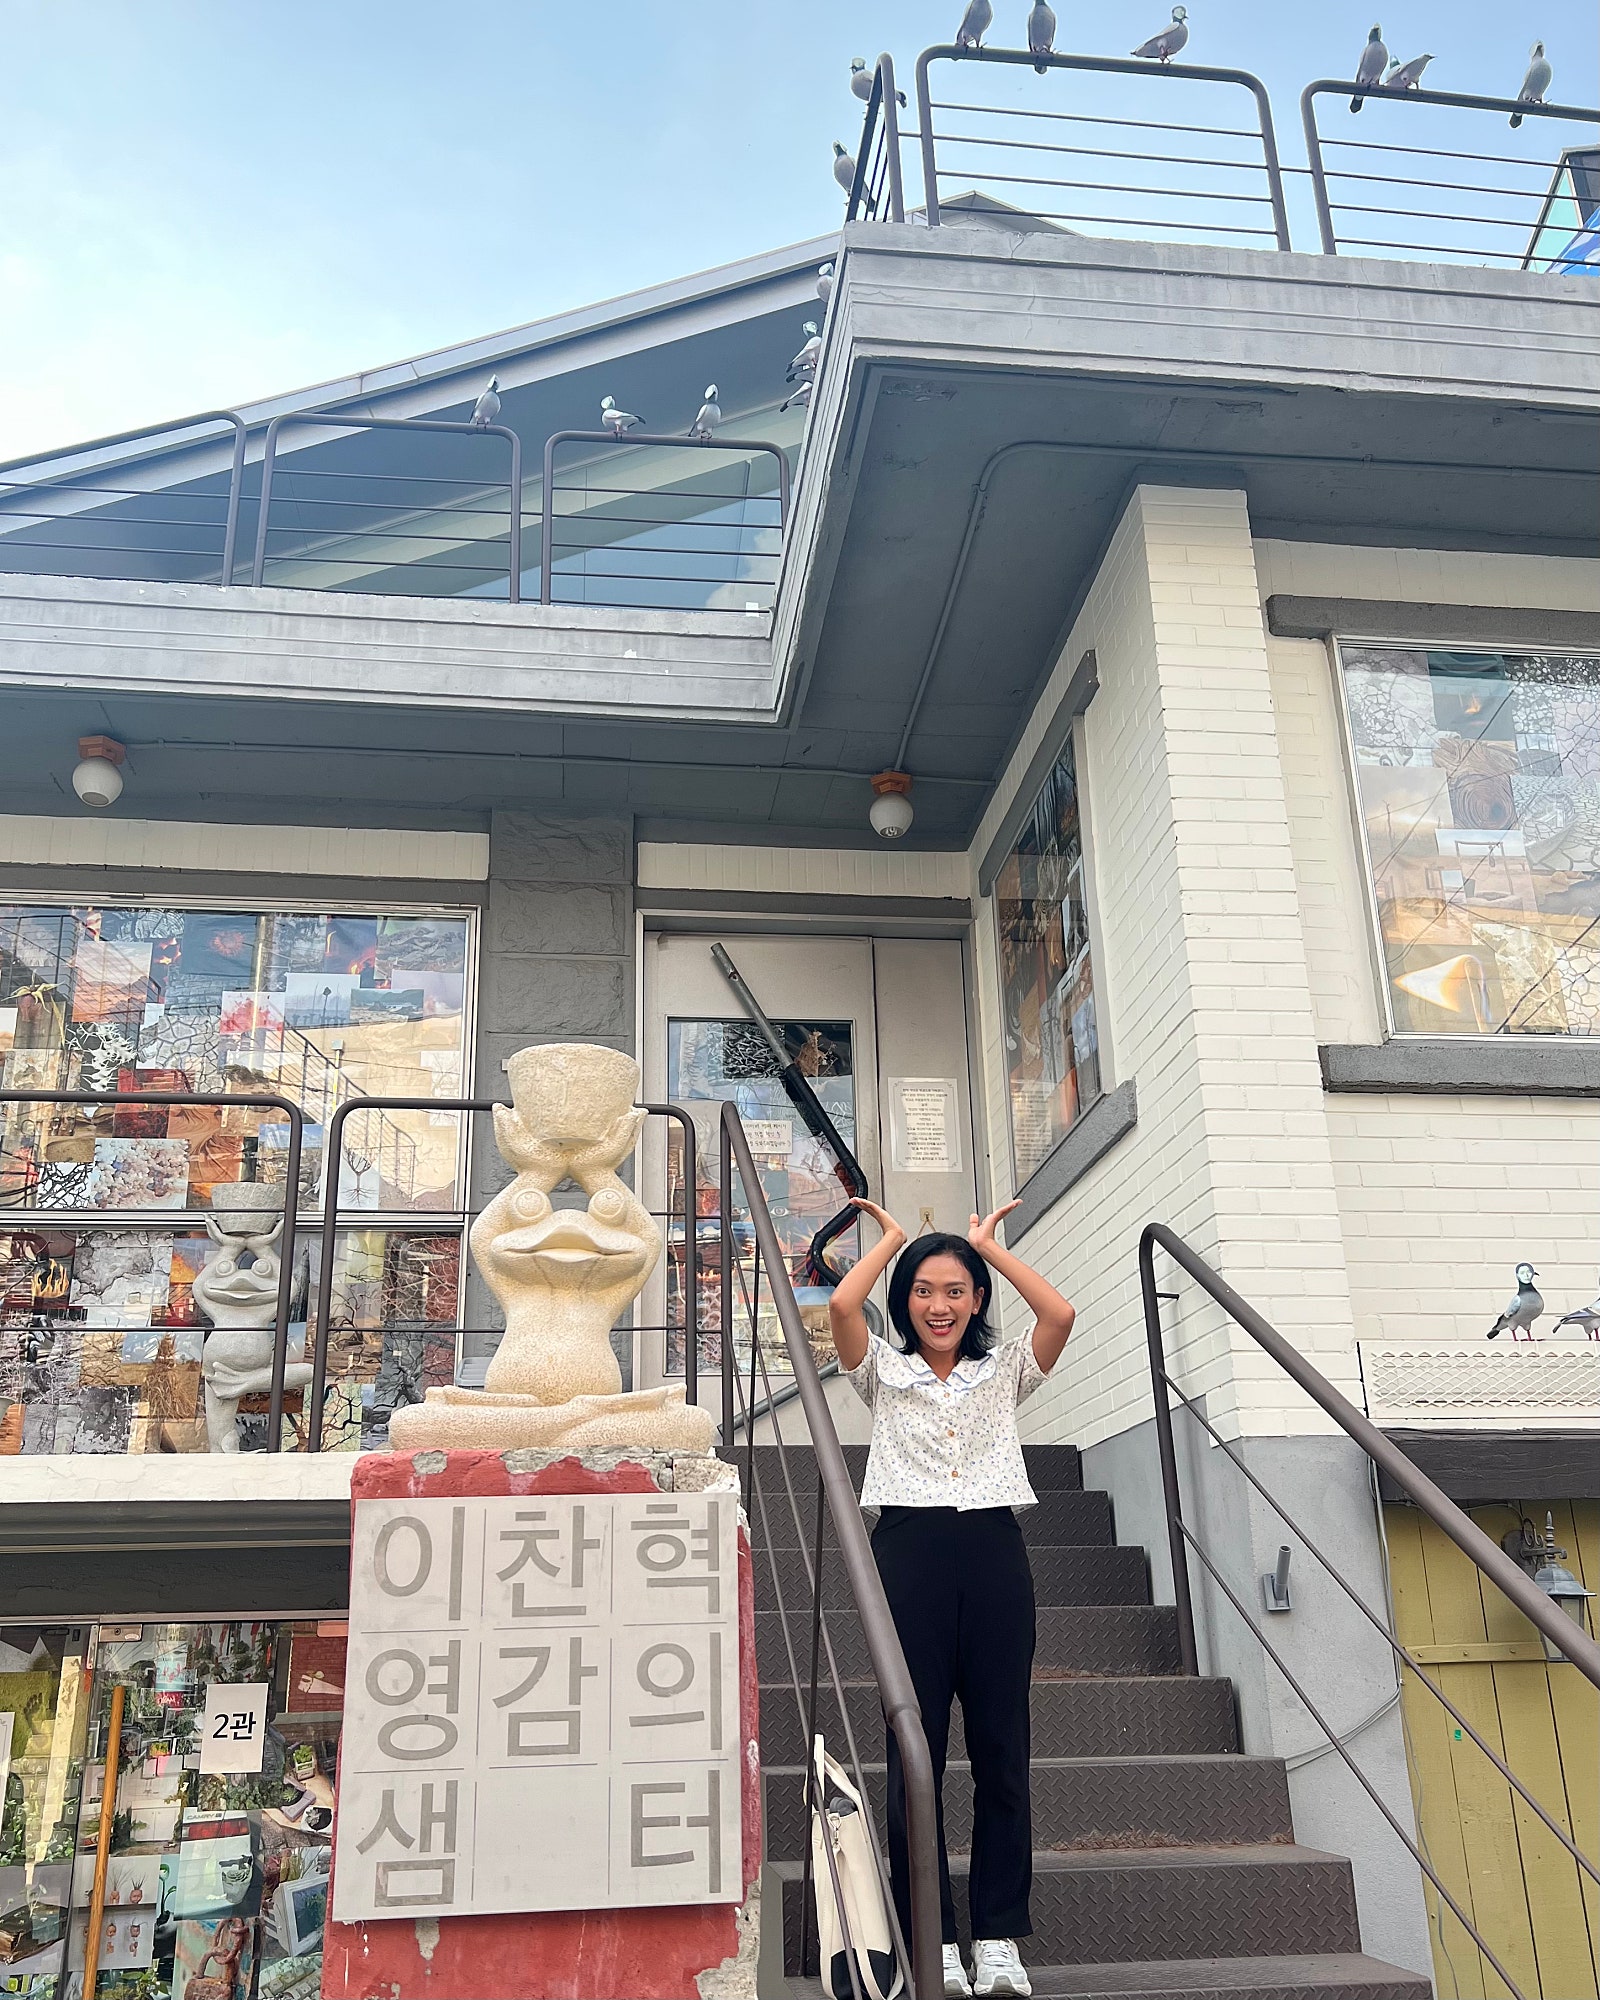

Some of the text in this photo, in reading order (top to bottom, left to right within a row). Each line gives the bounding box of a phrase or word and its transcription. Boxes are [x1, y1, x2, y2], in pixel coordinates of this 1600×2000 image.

[372, 1500, 721, 1621] 이찬혁
[212, 1711, 257, 1741] 2관
[364, 1631, 723, 1761] 영감의
